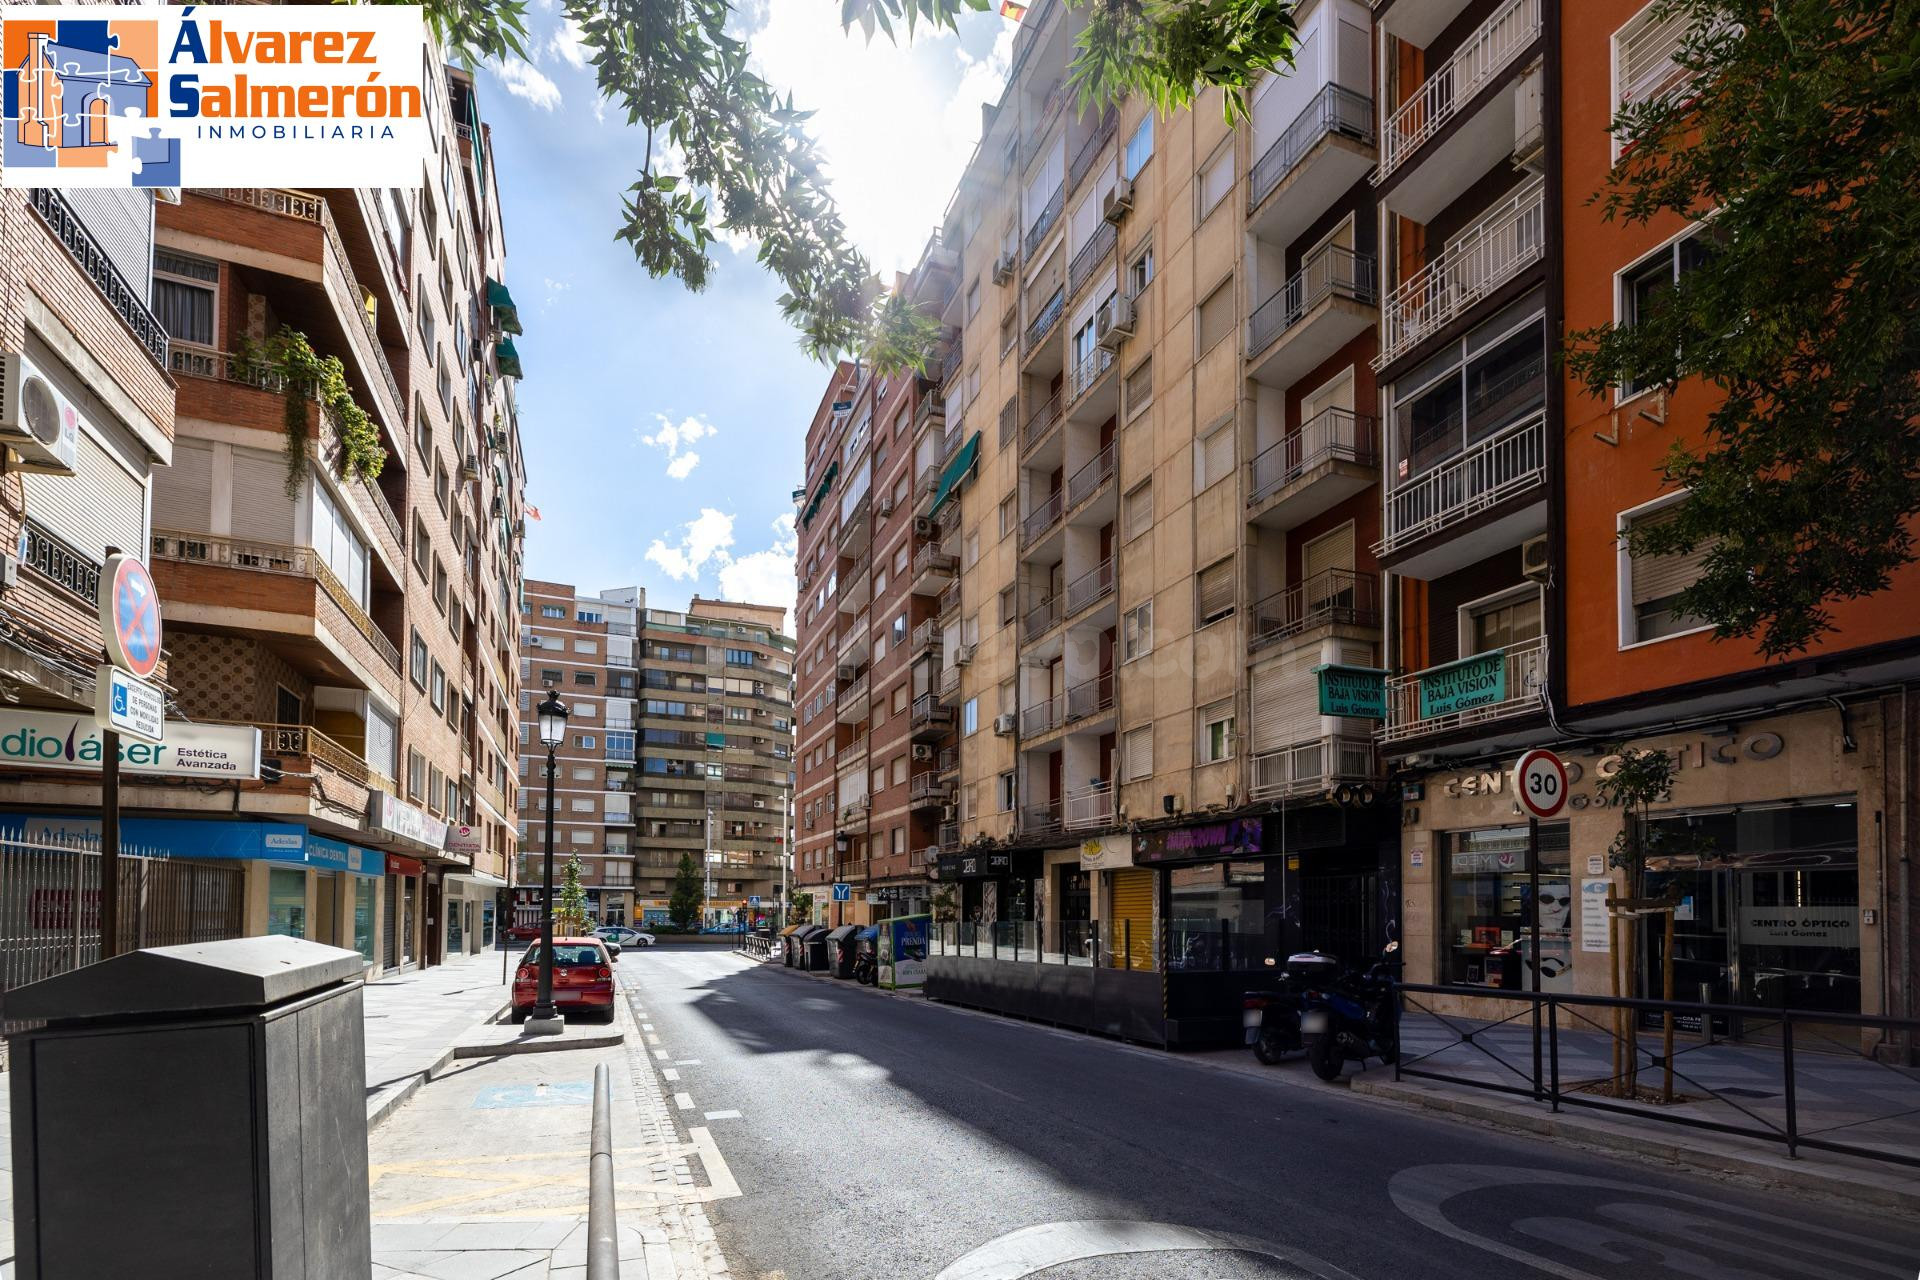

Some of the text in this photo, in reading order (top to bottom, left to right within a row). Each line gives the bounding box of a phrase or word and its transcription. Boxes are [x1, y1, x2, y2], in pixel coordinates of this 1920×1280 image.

[1325, 672, 1383, 690] INSTITUTO DE
[1423, 658, 1501, 690] INSTITUTO DE
[1328, 687, 1381, 703] BAJA VISION
[1427, 674, 1497, 702] BAJA VISION
[1330, 702, 1349, 714] Luis
[1430, 693, 1495, 715] Luis Gómez
[177, 746, 228, 759] Estética
[176, 758, 237, 771] Avanzada
[1529, 772, 1557, 796] 30
[270, 836, 299, 846] Adeslas
[328, 848, 347, 863] DENTAL
[1752, 917, 1850, 929] CENTRO ÓPTICO
